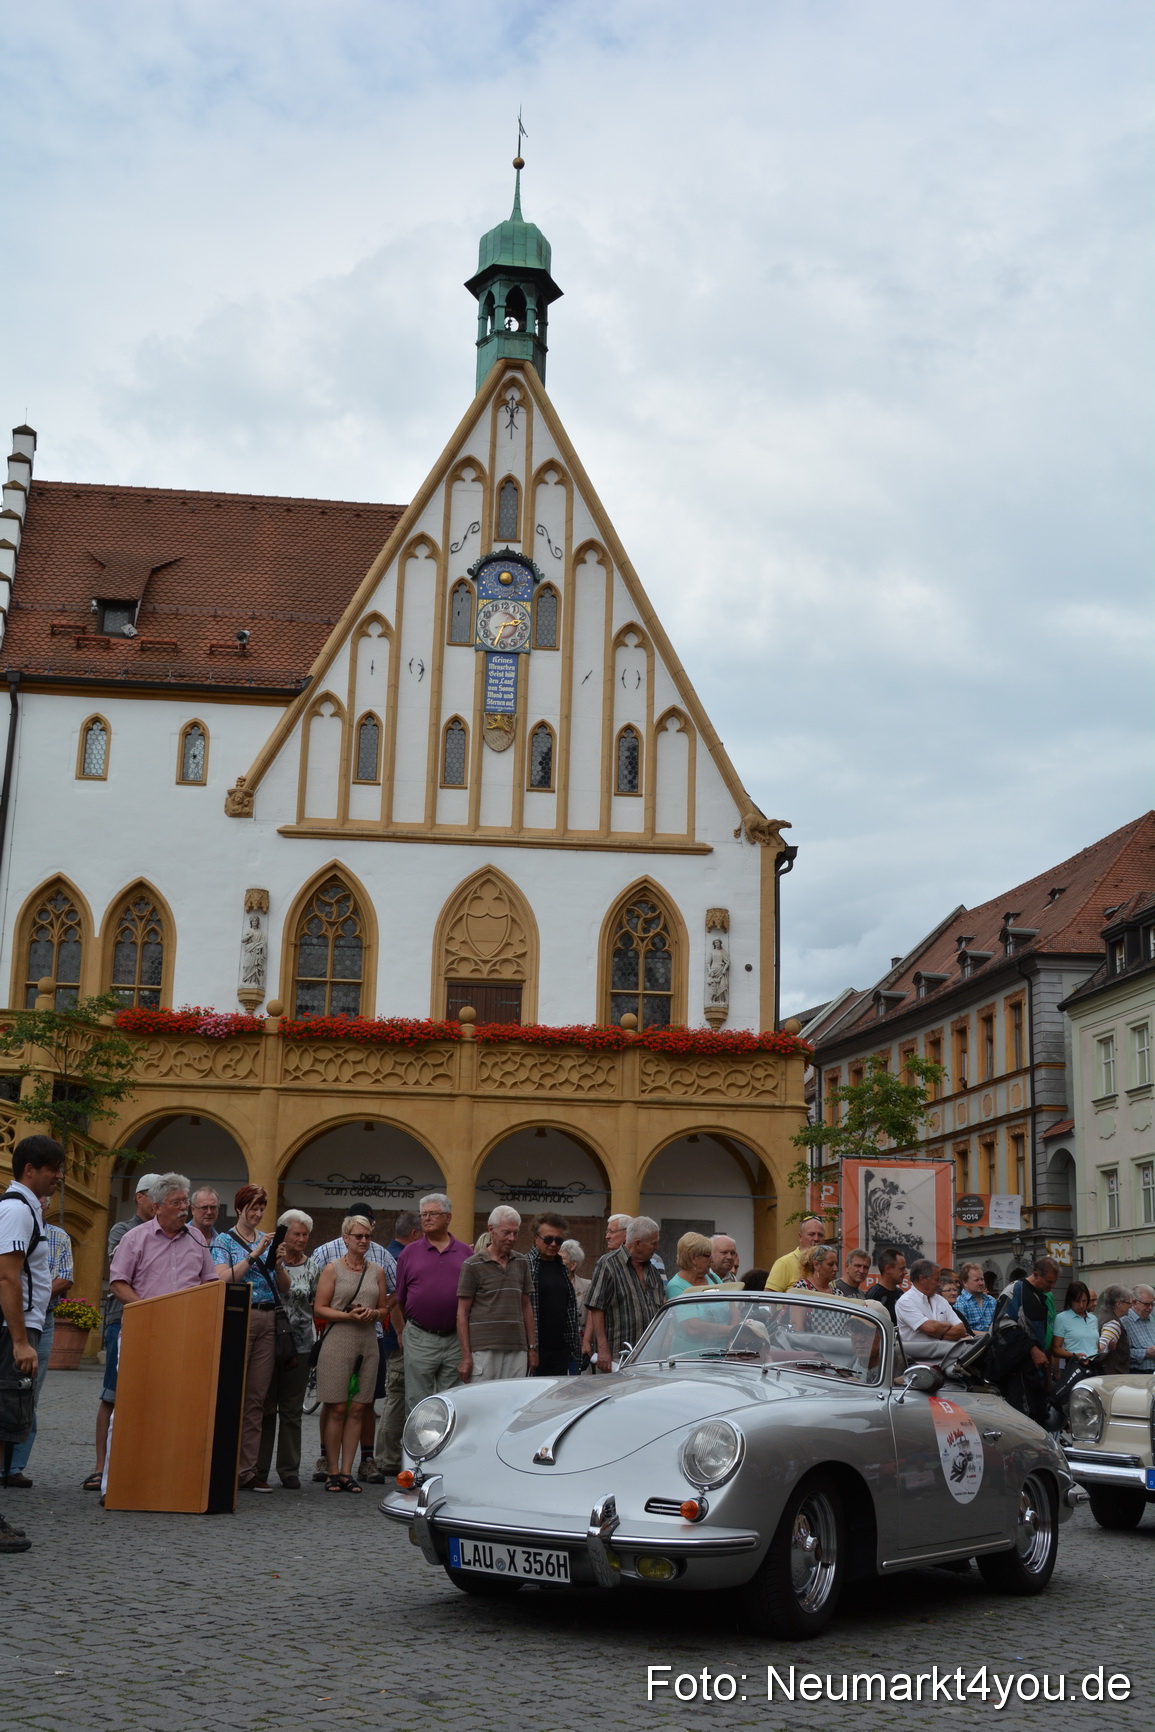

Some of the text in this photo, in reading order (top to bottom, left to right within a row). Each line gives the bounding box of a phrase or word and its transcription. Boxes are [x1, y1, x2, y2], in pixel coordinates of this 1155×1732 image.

[490, 604, 498, 612] 11
[500, 602, 509, 610] 12
[482, 610, 491, 619] 10
[1055, 1248, 1066, 1258] M
[460, 1542, 568, 1579] LAU X 356H
